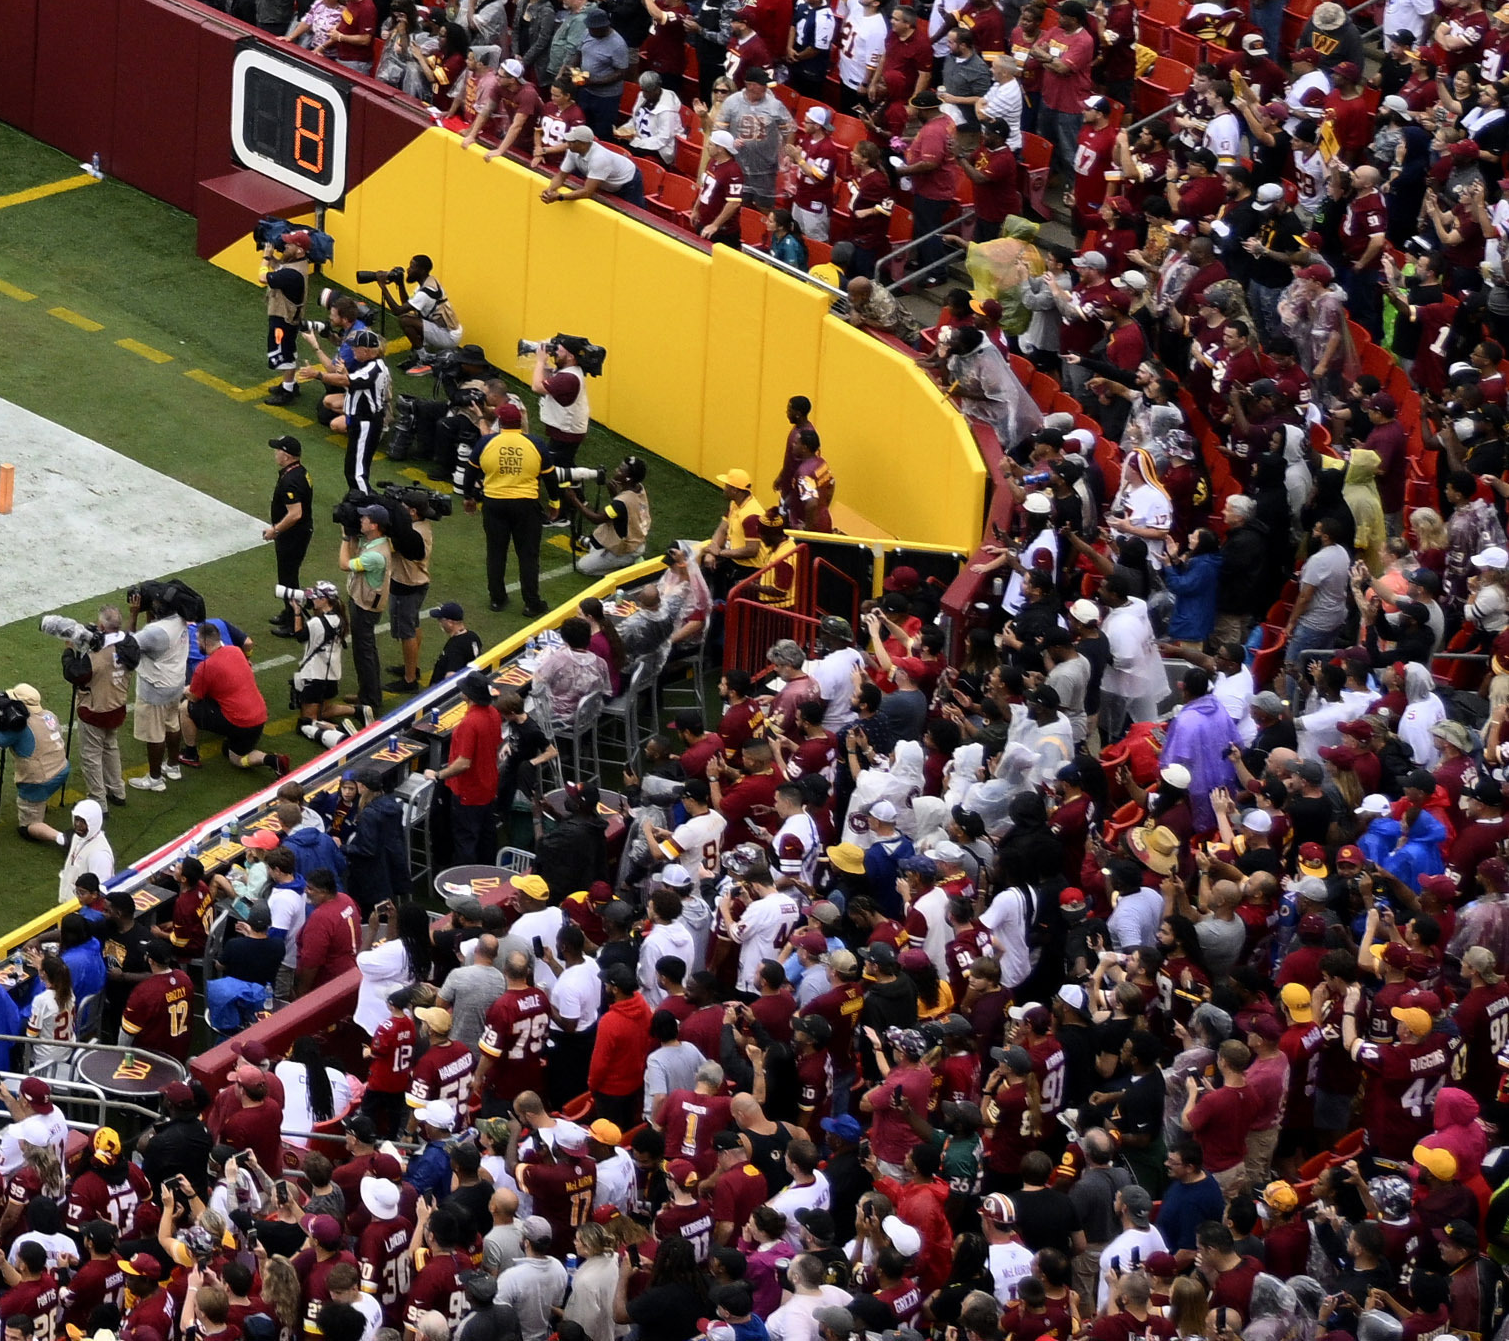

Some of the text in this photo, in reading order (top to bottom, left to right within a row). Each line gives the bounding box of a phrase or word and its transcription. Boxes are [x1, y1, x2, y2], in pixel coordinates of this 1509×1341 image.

[498, 445, 523, 456] CSC
[499, 456, 523, 466] EVENT
[499, 466, 523, 476] STAFF
[702, 840, 717, 871] 8
[168, 1000, 188, 1037] 12
[508, 1013, 549, 1059] 79
[392, 1046, 413, 1072] 12
[1401, 1075, 1447, 1117] 44
[570, 1191, 592, 1228] 17
